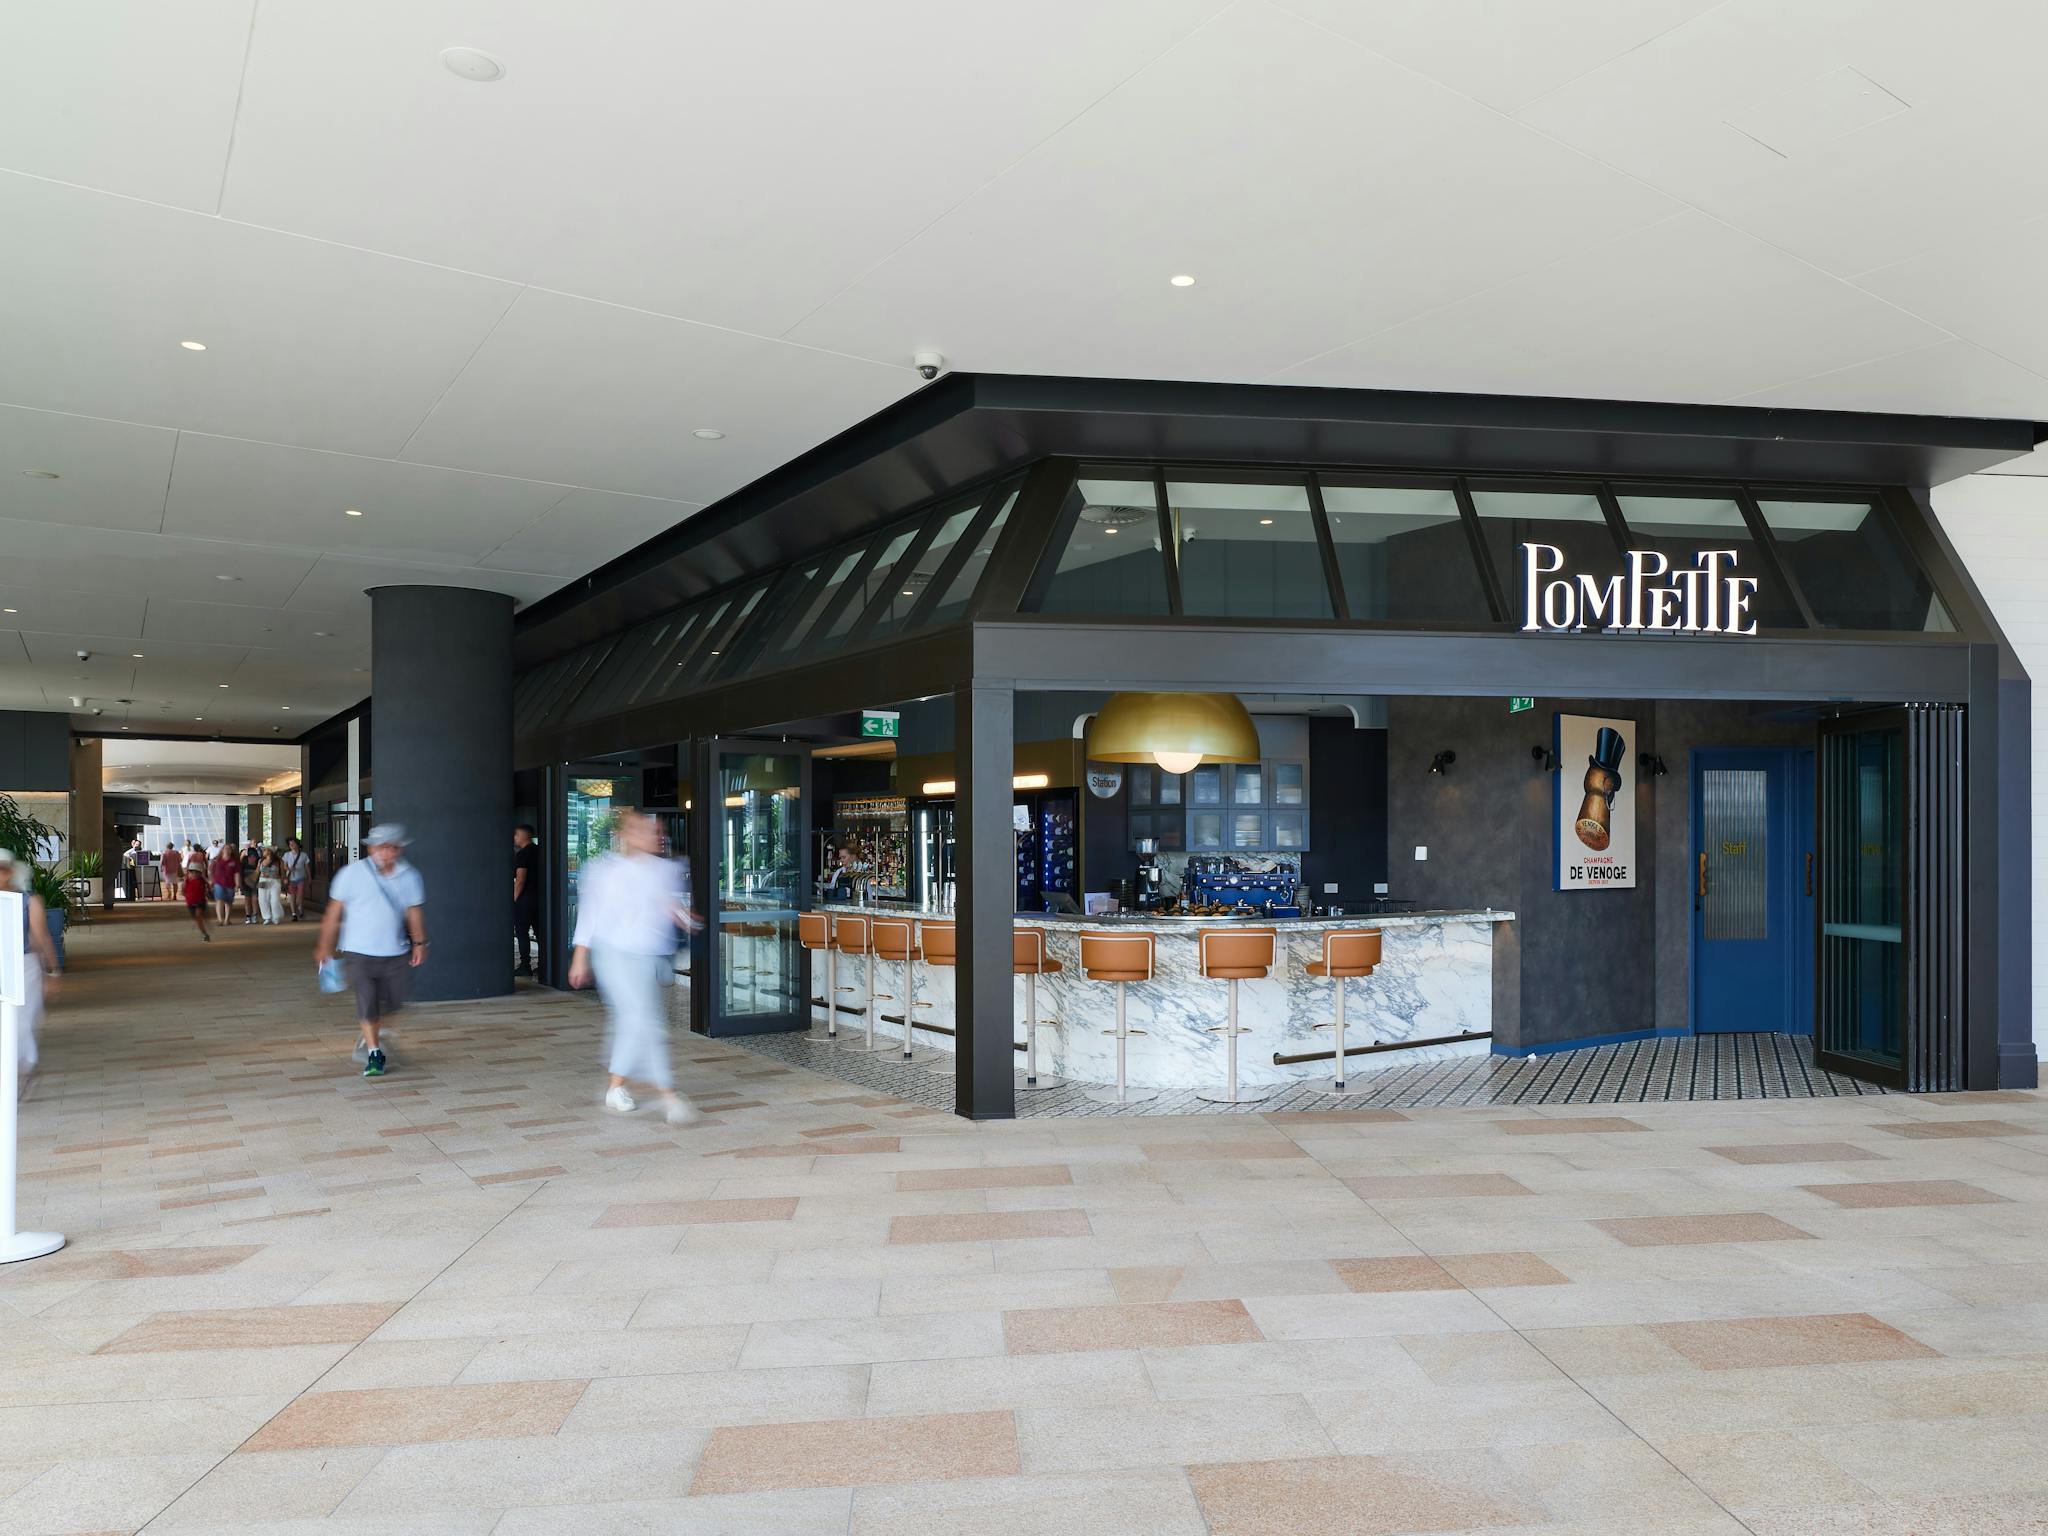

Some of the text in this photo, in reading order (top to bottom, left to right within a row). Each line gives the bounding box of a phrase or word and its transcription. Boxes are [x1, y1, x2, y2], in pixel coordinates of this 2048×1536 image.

[1522, 542, 1758, 635] POMPETTE
[1092, 776, 1117, 788] Station
[1722, 839, 1747, 856] Staff
[1583, 856, 1614, 864] CHAMPAGNE
[1570, 866, 1627, 880] DE VENOGE
